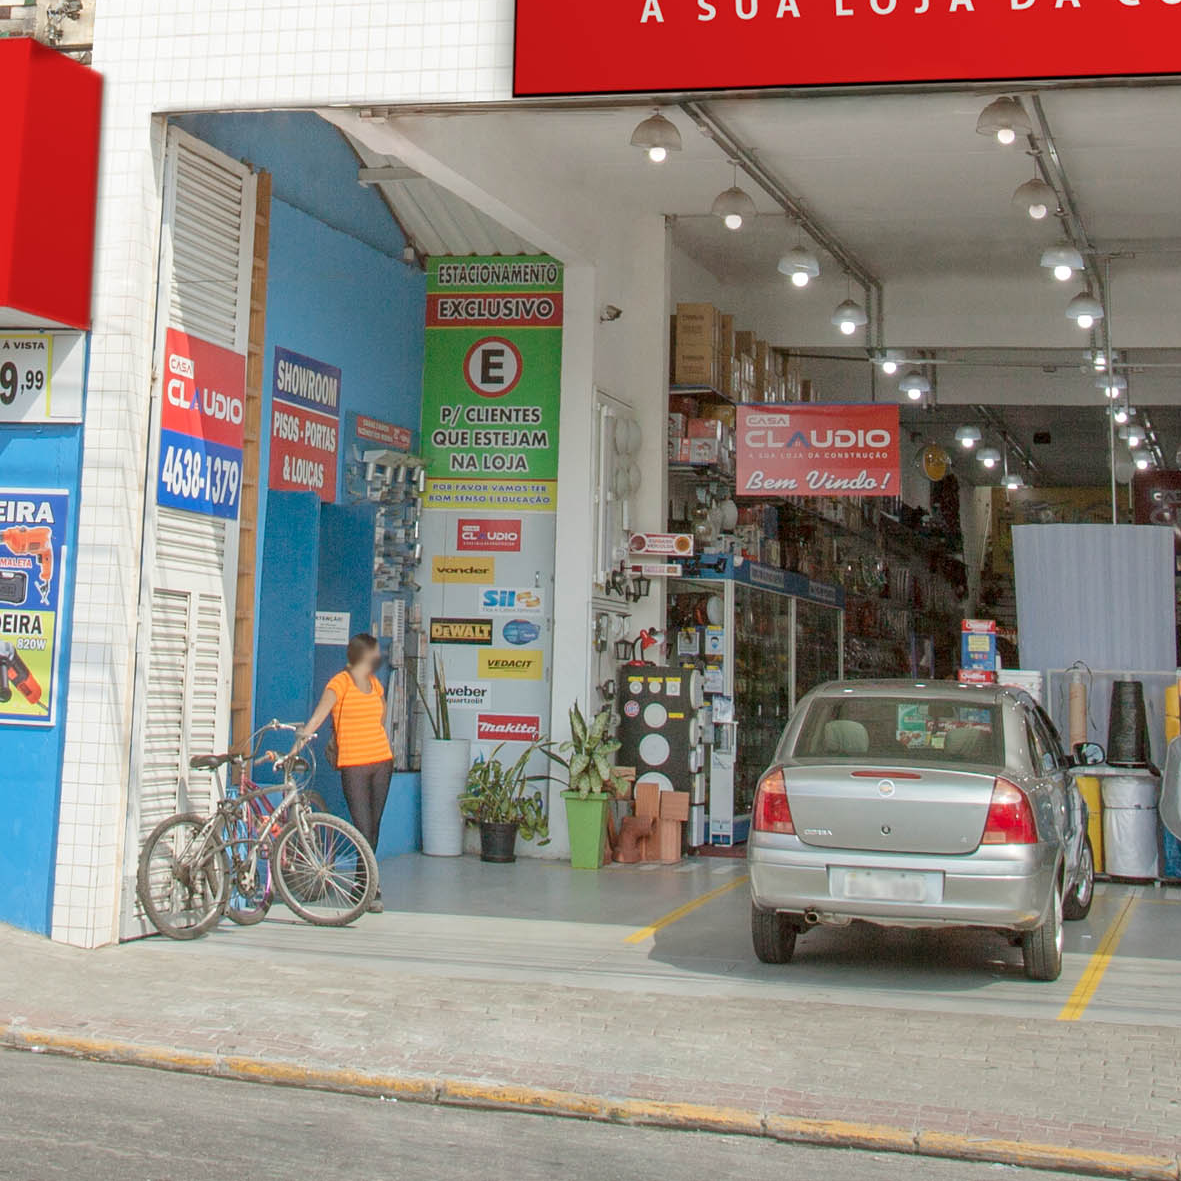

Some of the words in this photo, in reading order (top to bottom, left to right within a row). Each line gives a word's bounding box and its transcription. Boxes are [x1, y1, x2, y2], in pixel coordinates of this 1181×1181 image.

[438, 263, 558, 286] ESTACIONAMENTO
[438, 298, 554, 319] EXCLUSIVO
[14, 341, 45, 350] VISTA
[170, 358, 193, 374] CASA
[481, 349, 504, 384] E
[277, 359, 338, 407] SHOWROOM
[167, 379, 243, 425] CLAUDIO
[441, 405, 462, 427] P/
[465, 406, 541, 424] CLIENTES
[273, 411, 300, 443] PISOS
[304, 420, 337, 453] PORTAS
[432, 430, 469, 447] QUE
[473, 431, 549, 448] ESTEJAM
[745, 429, 892, 448] CLAUDIO
[450, 454, 478, 471] NA
[483, 454, 528, 472] LOJA
[824, 450, 889, 460] CONSTRUÇÃO
[162, 445, 240, 507] 4638-1379
[282, 455, 291, 481] &
[291, 457, 324, 490] LOUÇAS
[745, 470, 798, 490] Bem
[432, 483, 452, 491] POR
[455, 483, 488, 492] FAVOR
[491, 484, 528, 492] VAMOS
[531, 485, 547, 493] TER
[428, 494, 451, 502] BOM
[455, 495, 487, 503] SENSO
[495, 495, 551, 505] EDUCAÇÃO
[462, 531, 518, 541] CLAUDIO
[437, 566, 490, 574] vonder
[0, 614, 42, 634] EIRA
[17, 638, 47, 651] 820W
[487, 659, 533, 668] VEDACIT
[446, 685, 487, 697] weber
